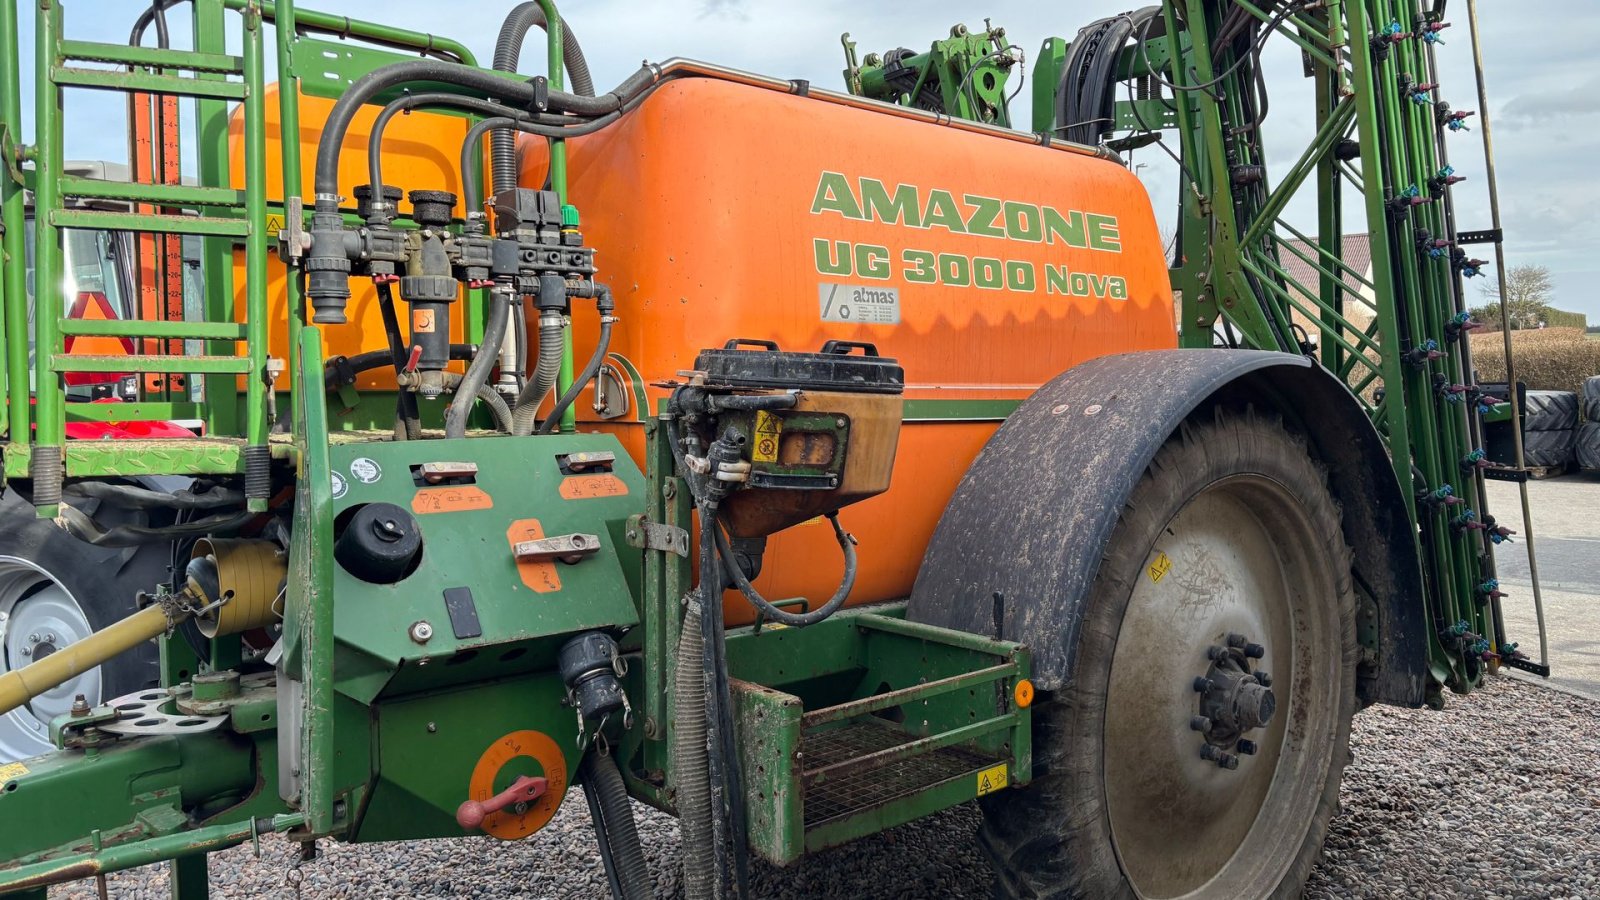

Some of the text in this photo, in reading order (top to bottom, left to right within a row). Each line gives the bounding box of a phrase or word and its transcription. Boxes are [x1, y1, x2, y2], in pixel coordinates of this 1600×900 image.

[810, 170, 1122, 253] AMAZONE
[813, 238, 1128, 300] UG 3000 Nova
